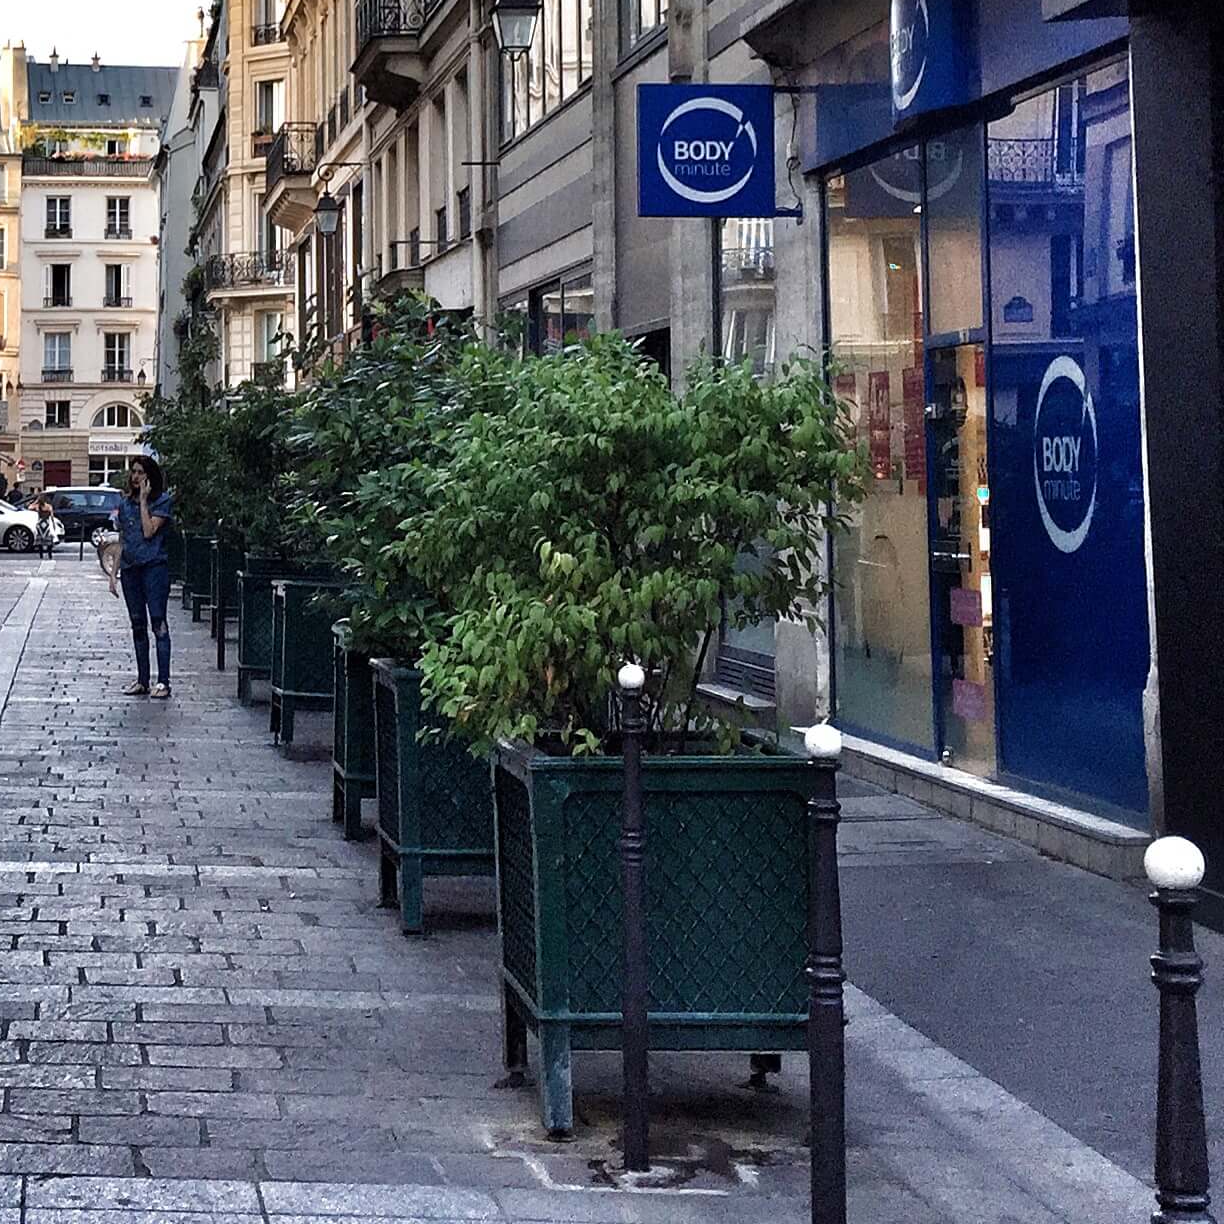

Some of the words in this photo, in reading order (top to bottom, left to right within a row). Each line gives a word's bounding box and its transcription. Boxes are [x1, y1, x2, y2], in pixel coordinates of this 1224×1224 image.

[674, 141, 734, 161] BODY
[674, 162, 732, 177] minute
[1042, 436, 1082, 473] BODY
[1043, 478, 1081, 502] minute
